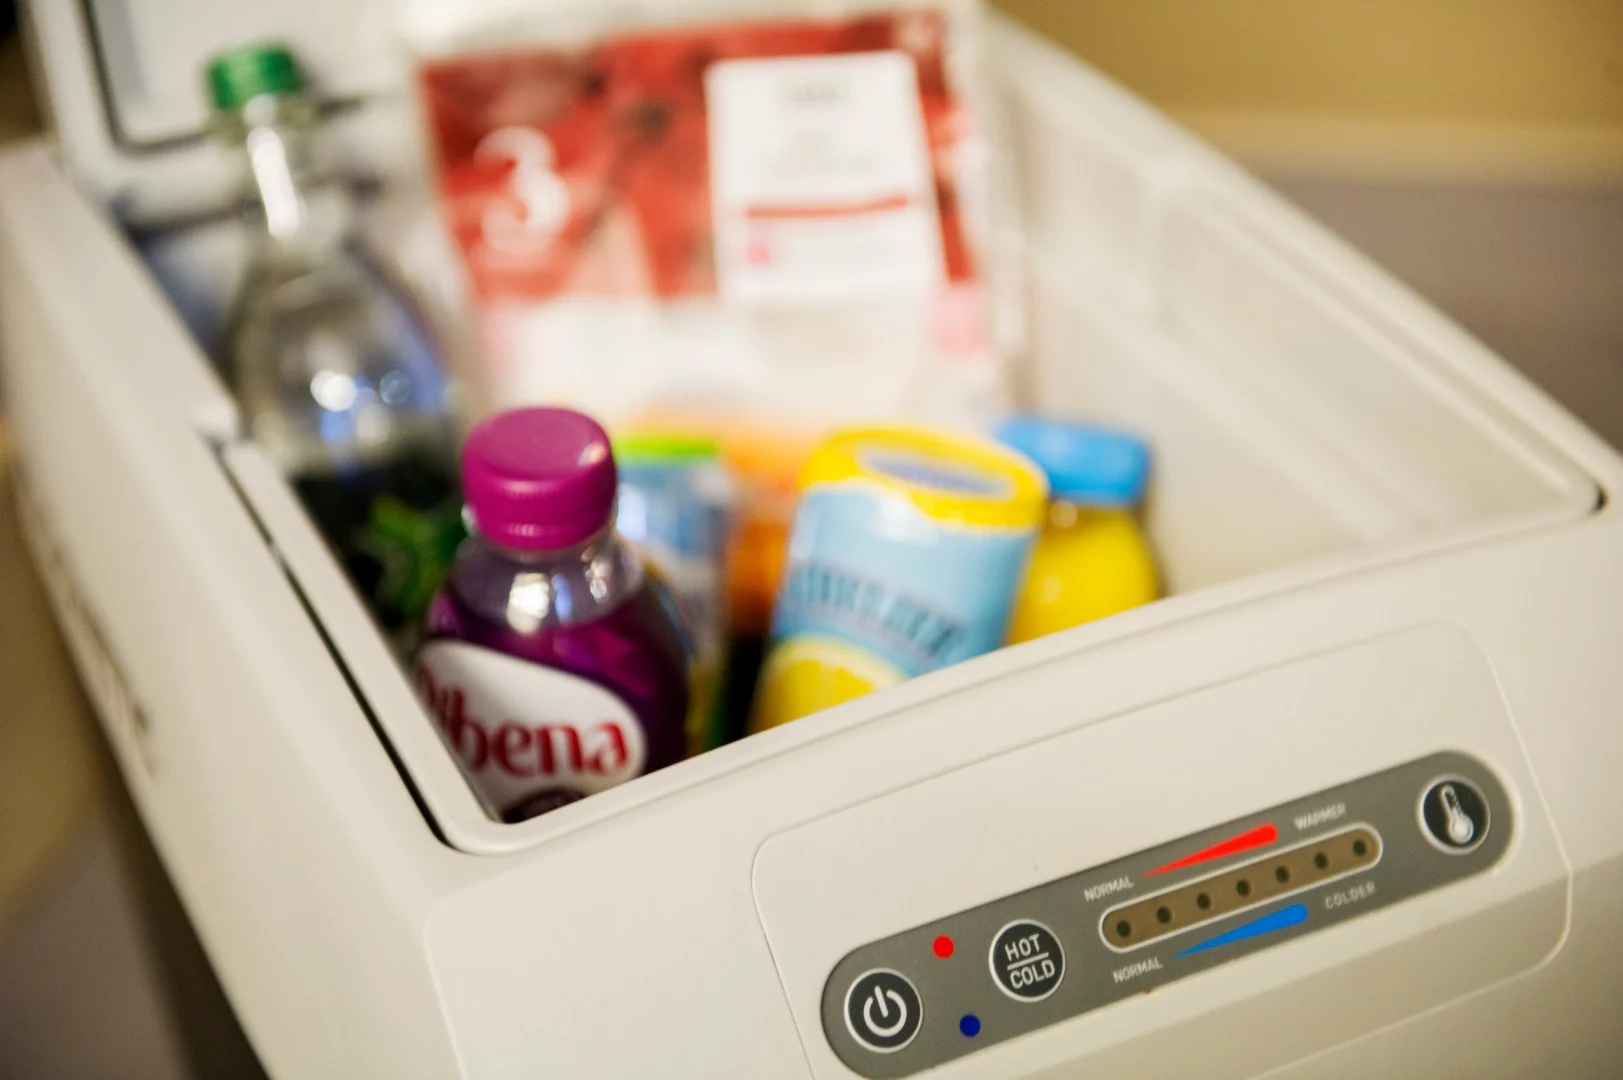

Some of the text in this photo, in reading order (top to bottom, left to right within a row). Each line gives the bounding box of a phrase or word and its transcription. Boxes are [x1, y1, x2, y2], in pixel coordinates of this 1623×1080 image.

[473, 126, 571, 264] 3
[1294, 802, 1346, 831] WARMER
[1084, 876, 1134, 902] NORMAL
[1324, 882, 1375, 910] COLDER
[1005, 933, 1040, 962] HOT
[1010, 960, 1055, 989] COLD
[1112, 957, 1163, 984] NORMAL
